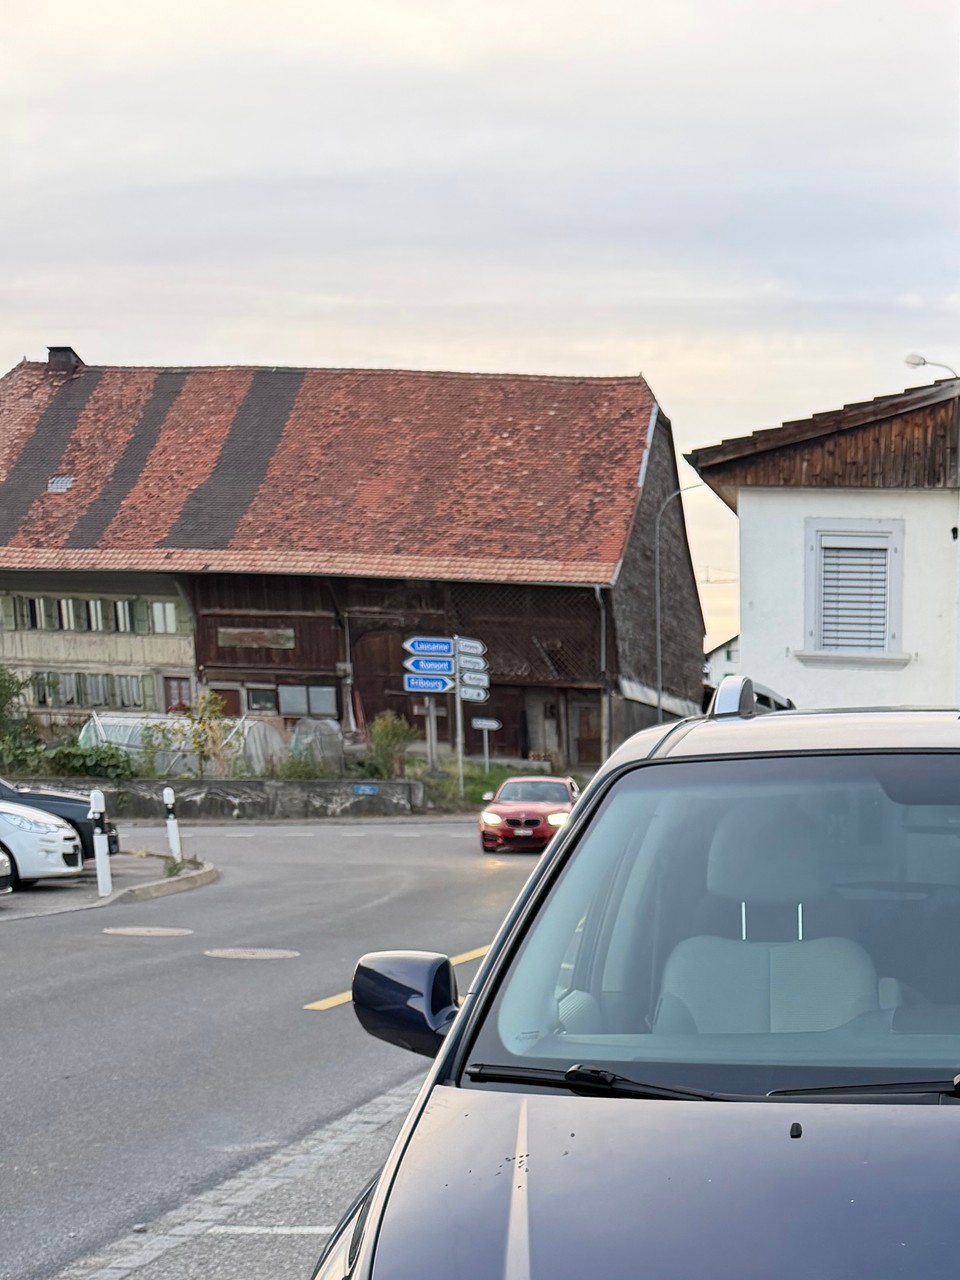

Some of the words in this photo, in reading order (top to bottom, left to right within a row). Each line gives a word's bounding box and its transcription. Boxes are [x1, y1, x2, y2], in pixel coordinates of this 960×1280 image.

[415, 641, 449, 652] Lausanne
[419, 660, 448, 671] Romont
[410, 678, 441, 690] Fribourg
